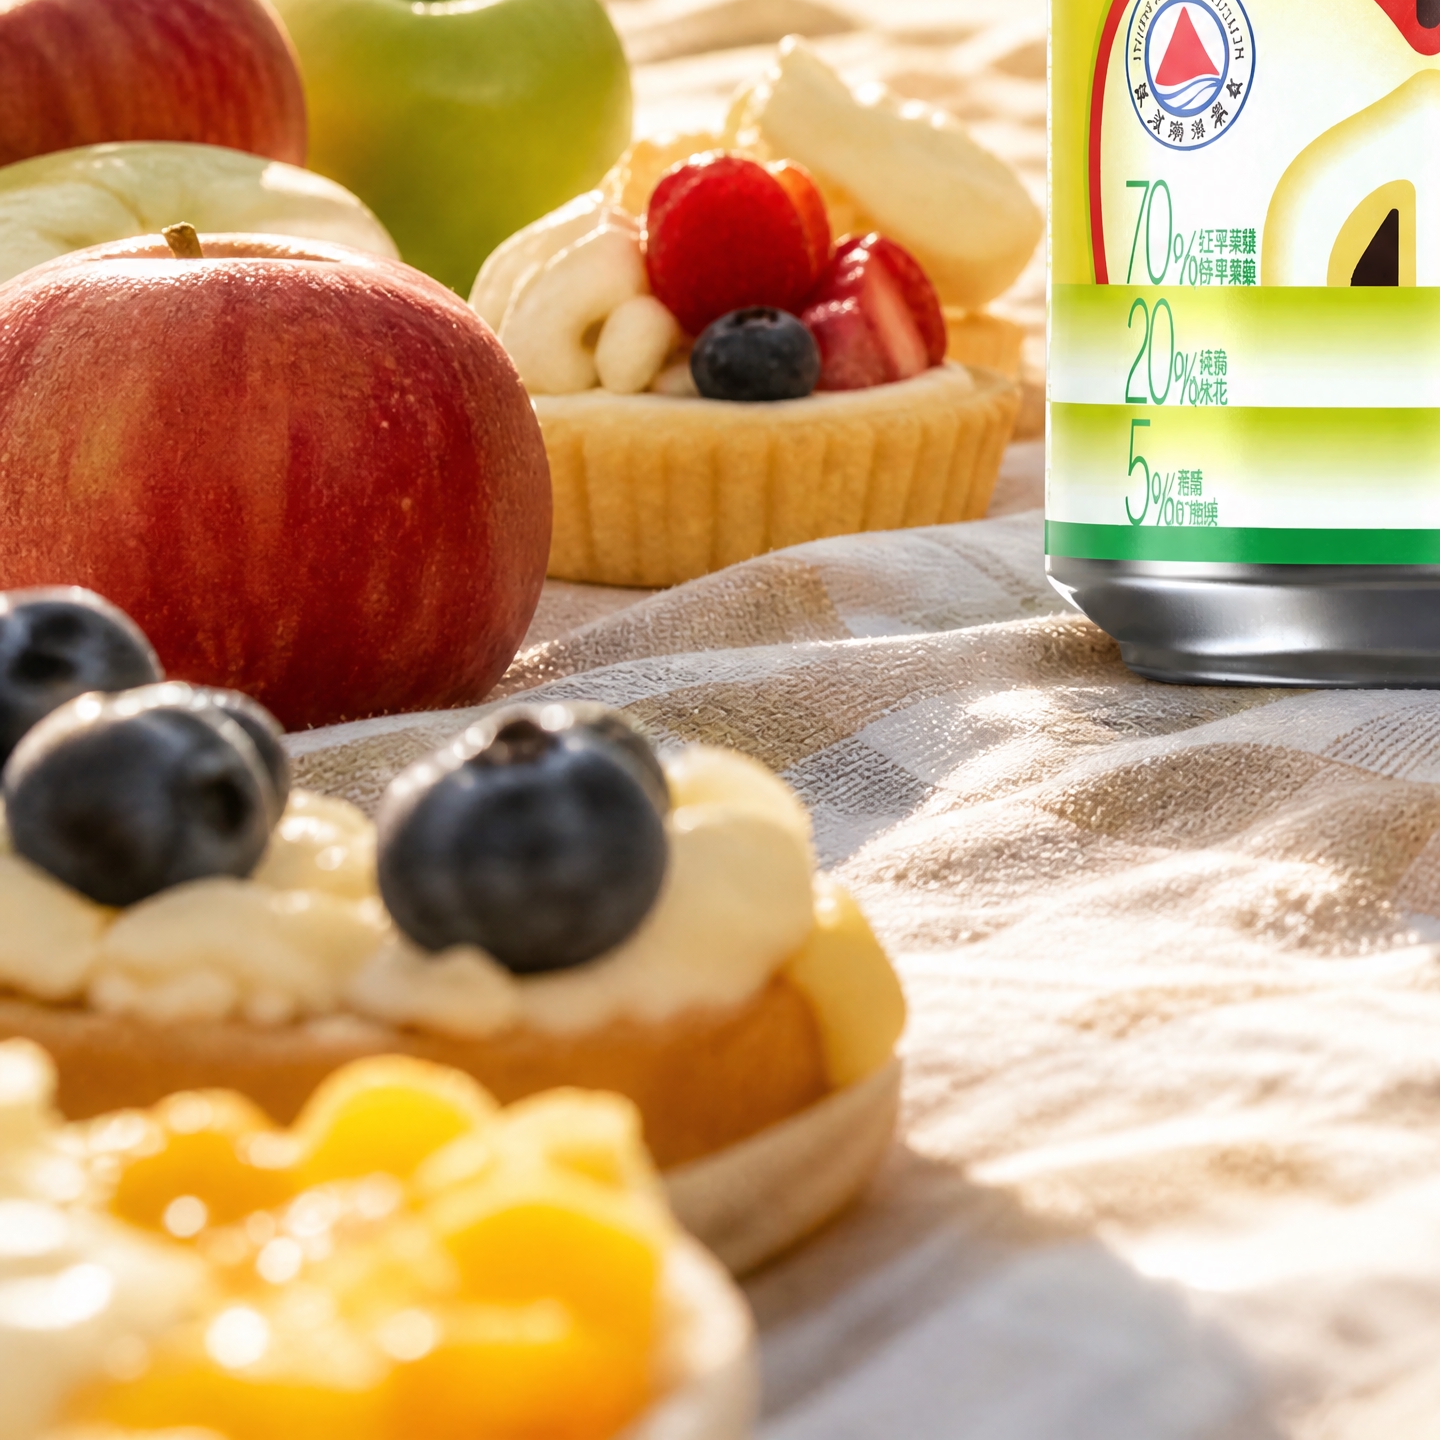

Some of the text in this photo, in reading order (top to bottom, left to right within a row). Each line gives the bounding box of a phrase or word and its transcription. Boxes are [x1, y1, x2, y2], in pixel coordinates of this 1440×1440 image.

[1125, 179, 1198, 287] 70%
[1125, 297, 1198, 406] 20%
[1125, 418, 1176, 527] 5%
